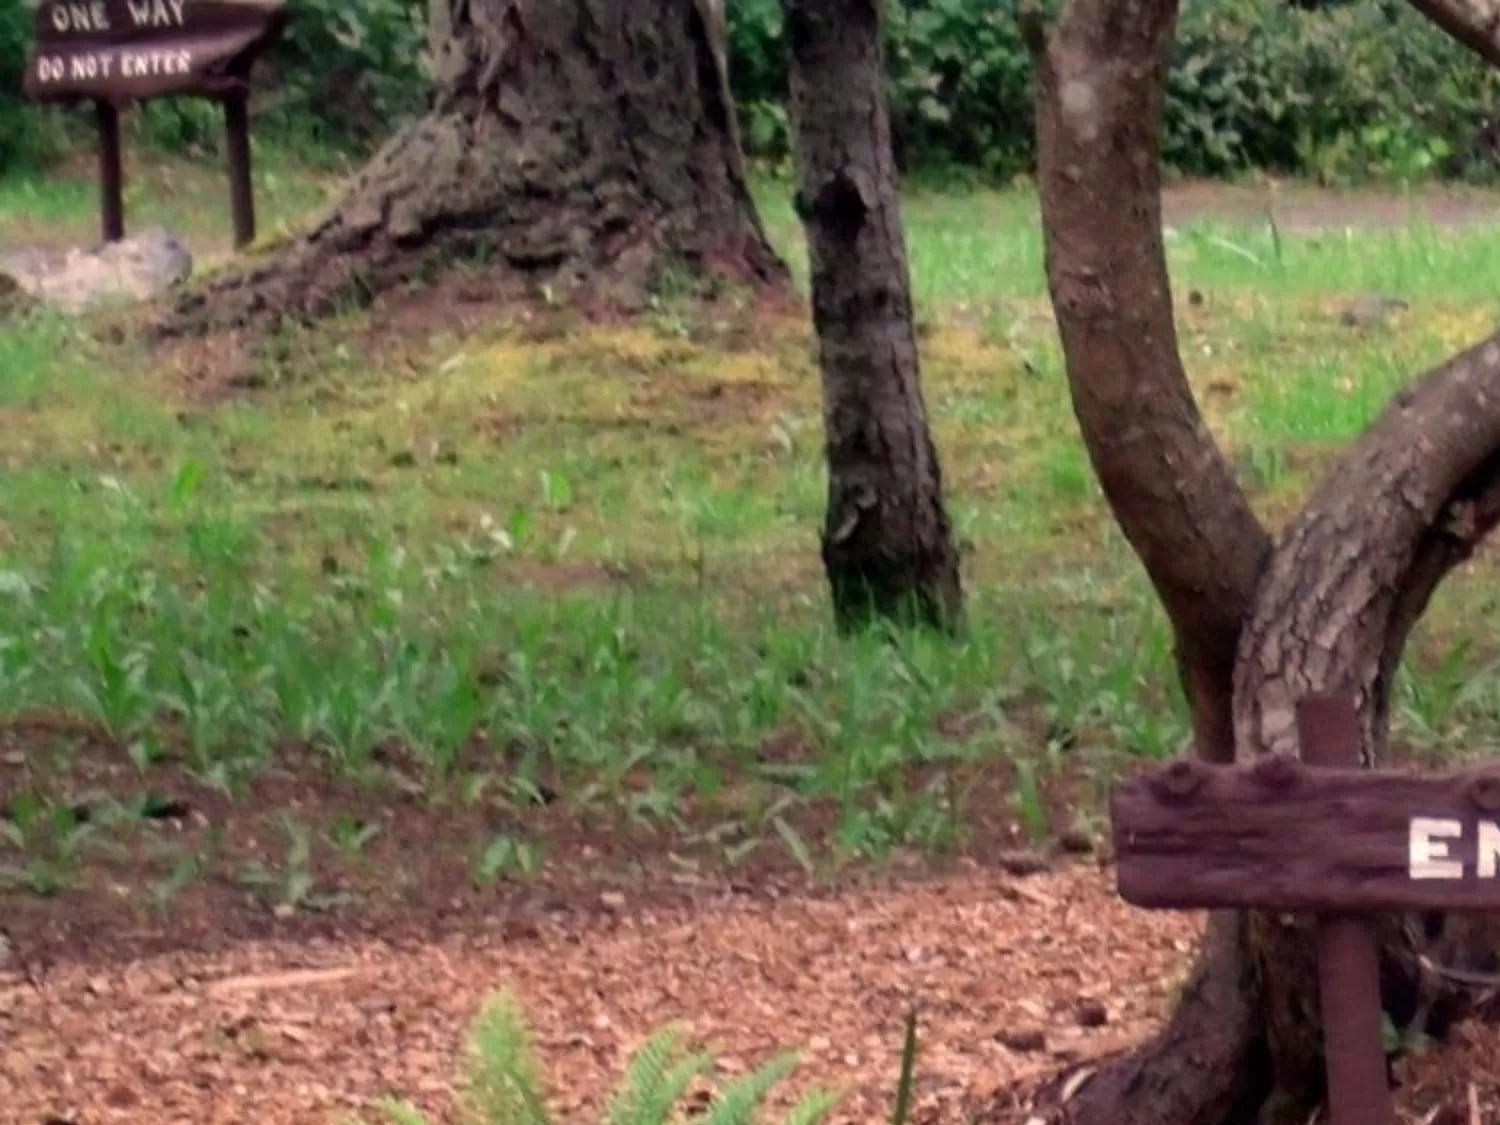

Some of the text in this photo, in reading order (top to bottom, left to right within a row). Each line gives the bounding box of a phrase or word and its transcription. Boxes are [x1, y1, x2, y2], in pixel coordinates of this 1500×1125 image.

[52, 0, 184, 31] ONE WAY
[37, 50, 191, 82] DO NOT ENTER
